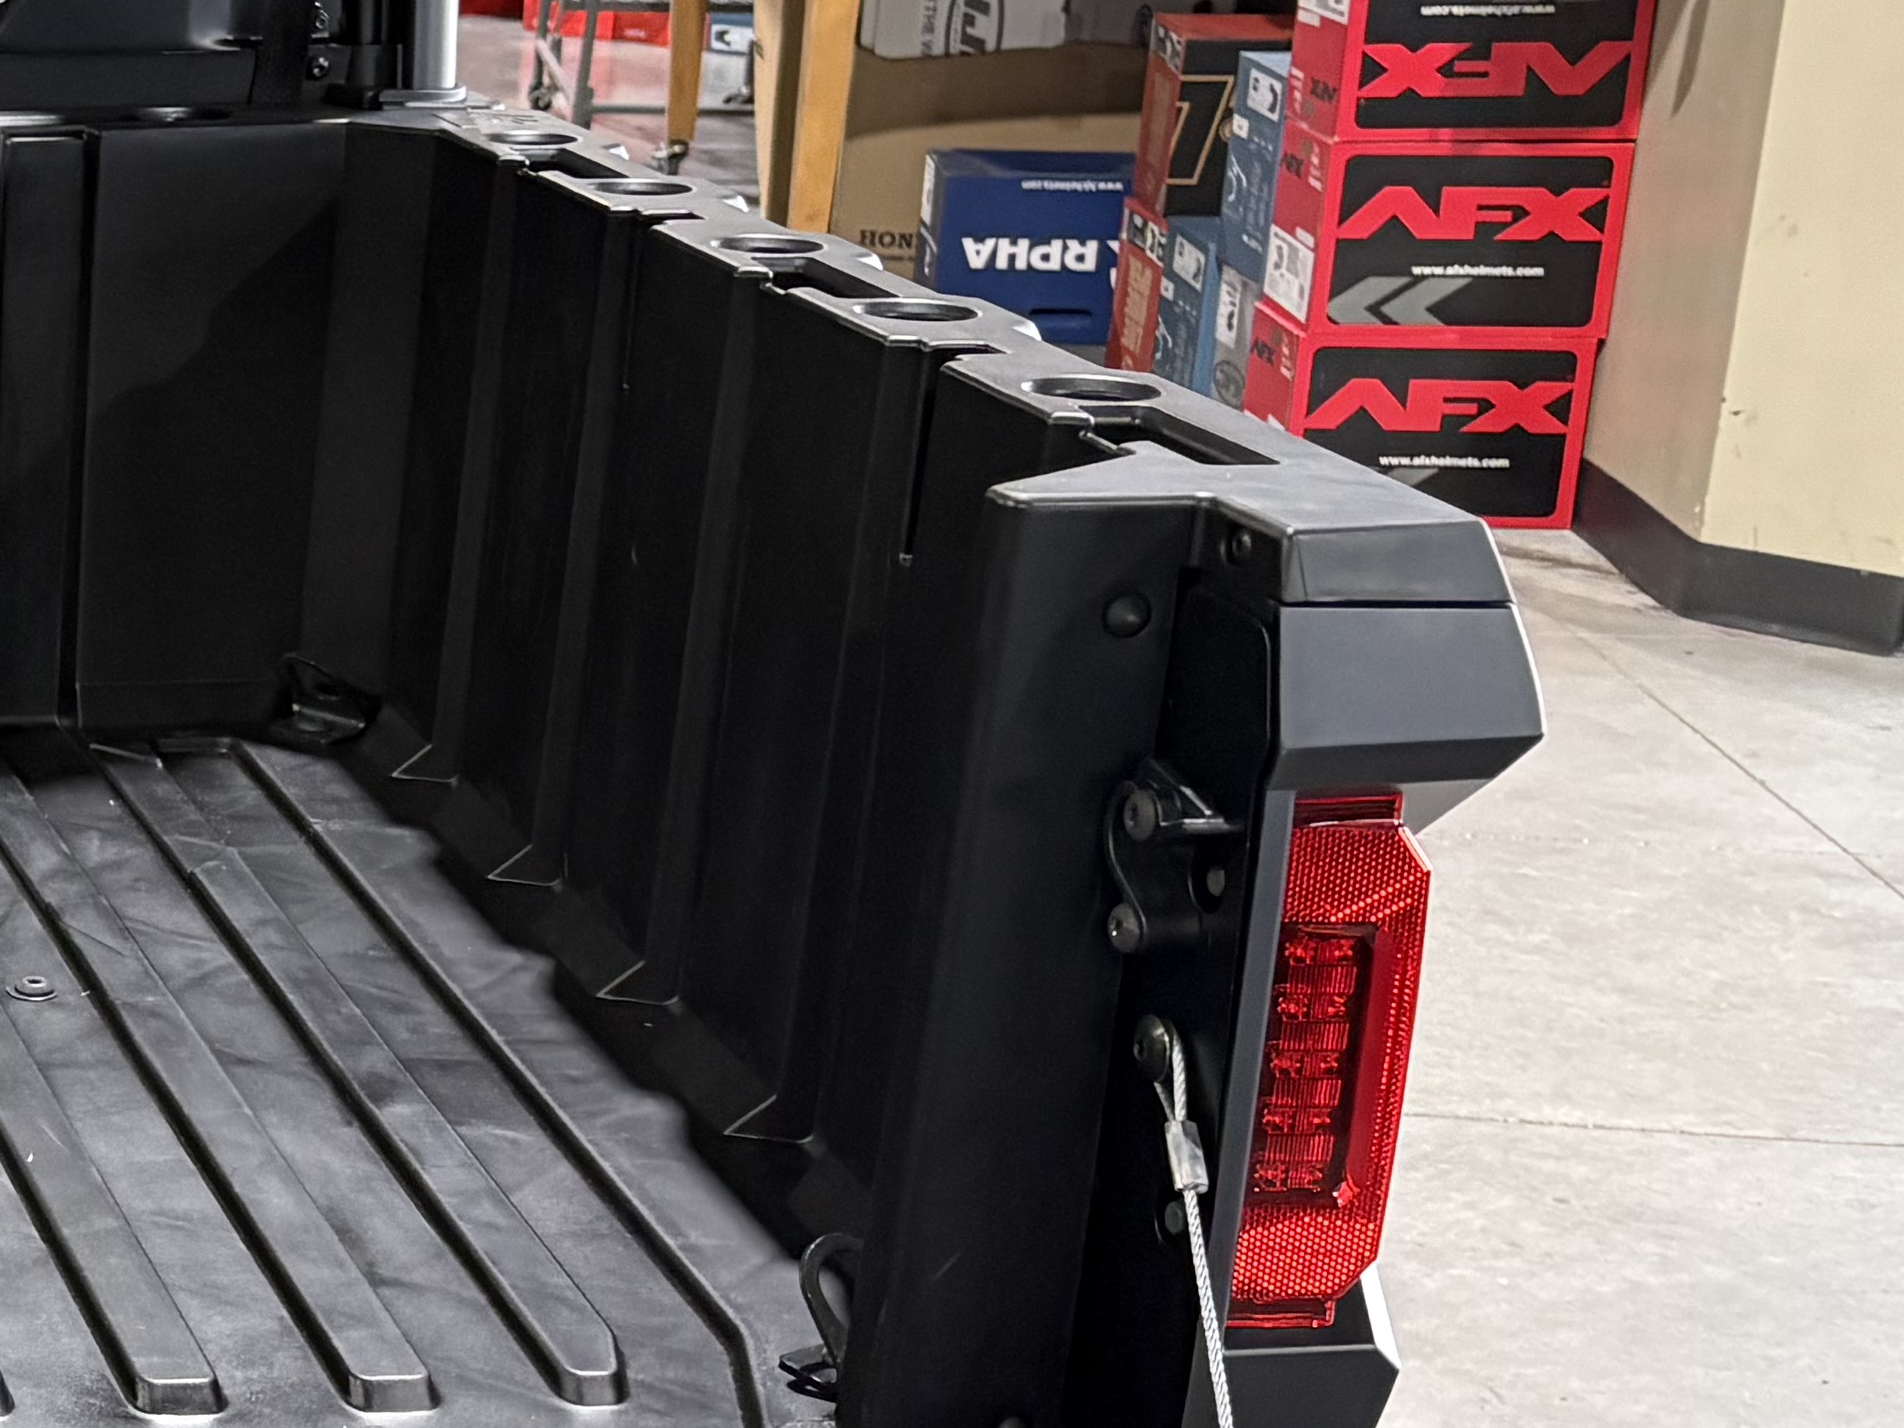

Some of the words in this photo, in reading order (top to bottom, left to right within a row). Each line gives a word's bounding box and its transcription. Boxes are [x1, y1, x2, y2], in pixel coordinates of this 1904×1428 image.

[1357, 41, 1633, 97] AFX
[1336, 186, 1611, 241] AFX
[961, 237, 1098, 273] RPHA
[1304, 378, 1575, 434] AFX
